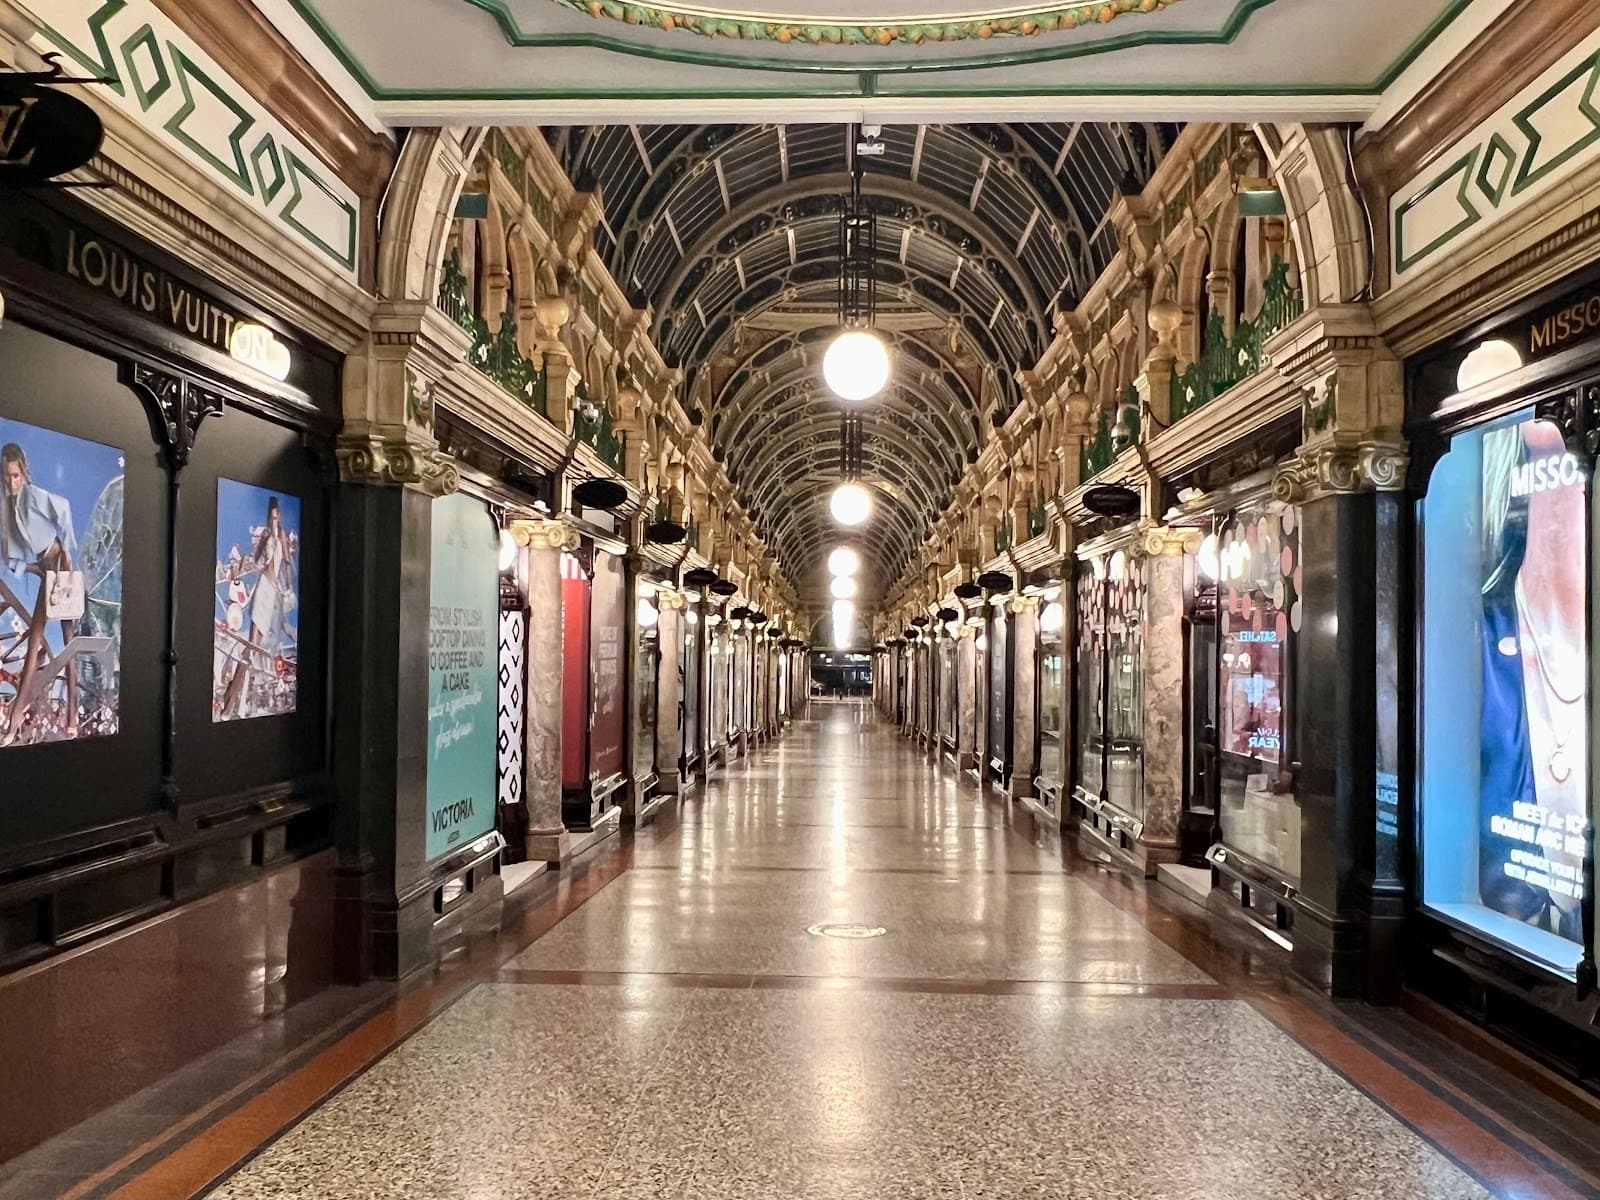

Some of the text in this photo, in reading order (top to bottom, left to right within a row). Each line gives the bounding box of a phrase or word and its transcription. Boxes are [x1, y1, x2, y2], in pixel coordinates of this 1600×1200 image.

[67, 229, 156, 312] LOUIS
[1530, 295, 1600, 353] MISSO
[438, 650, 468, 671] COFFEE
[469, 650, 484, 669] AND
[441, 671, 470, 693] A CAKE
[431, 795, 475, 834] VICTORIA
